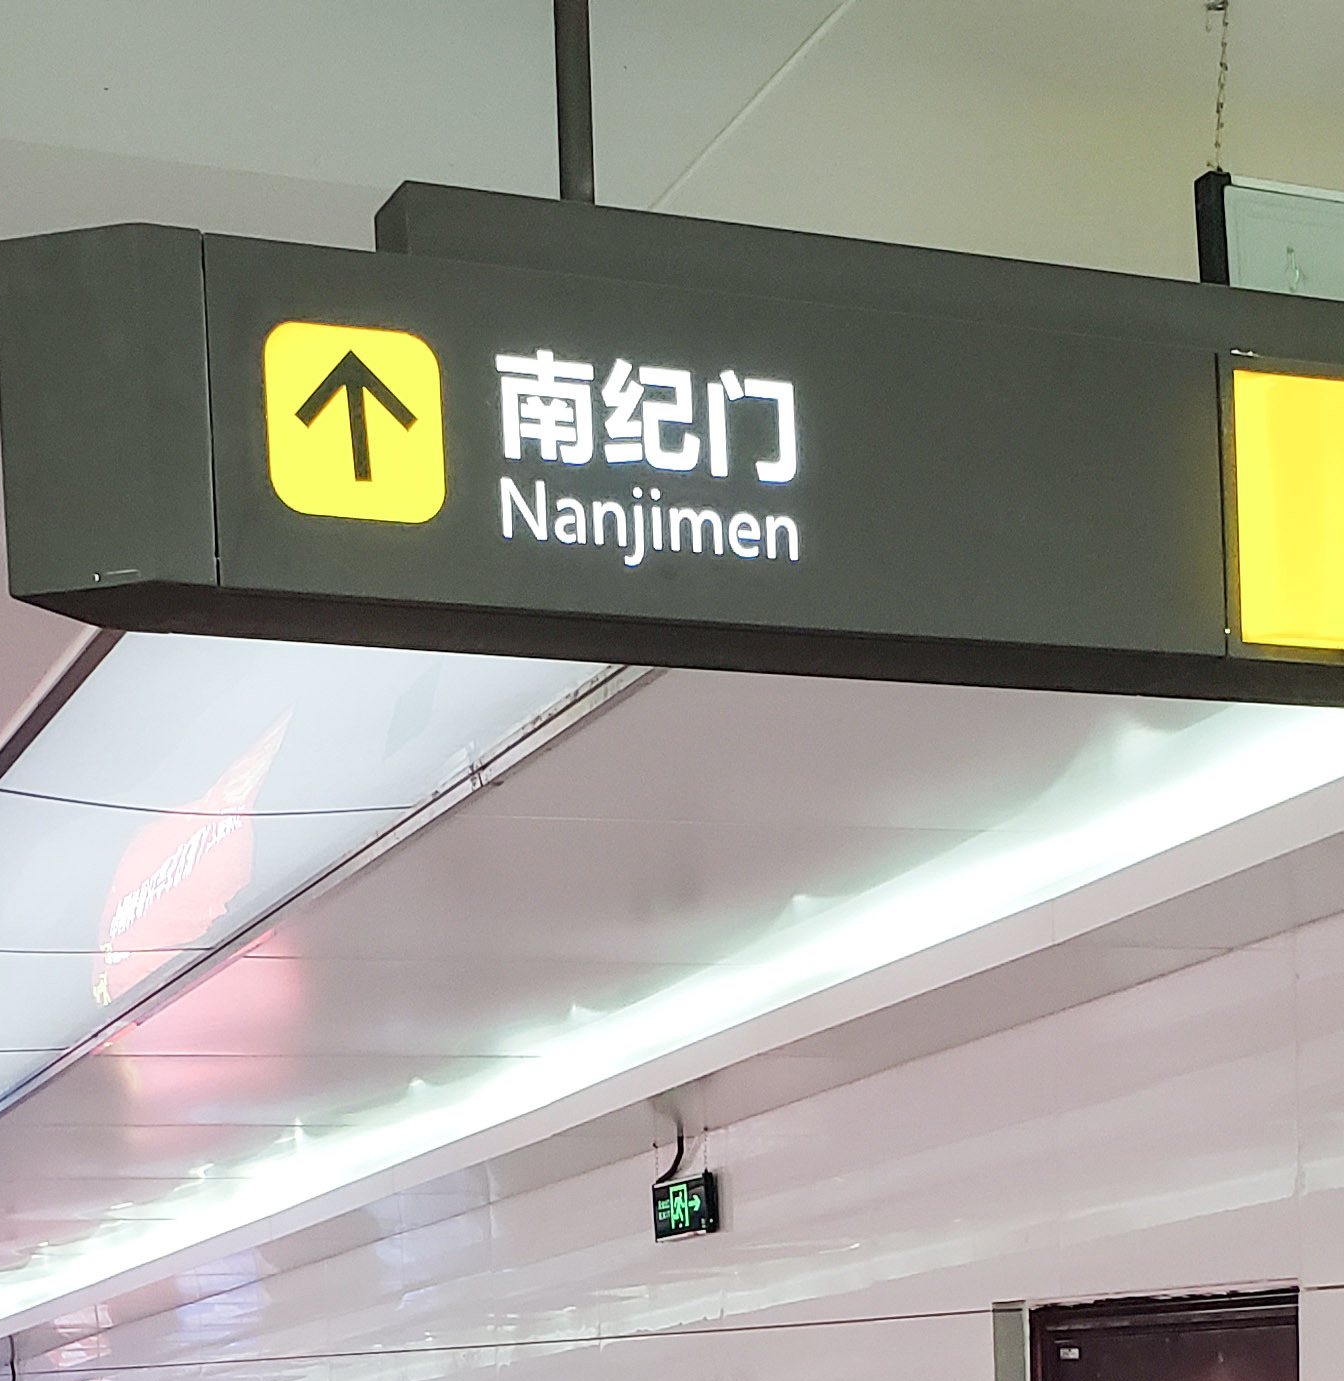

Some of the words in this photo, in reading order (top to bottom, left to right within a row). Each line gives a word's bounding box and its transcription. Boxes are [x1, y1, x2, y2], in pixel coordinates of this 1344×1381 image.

[495, 350, 798, 483] 南纪门
[500, 477, 799, 567] Nanjimen
